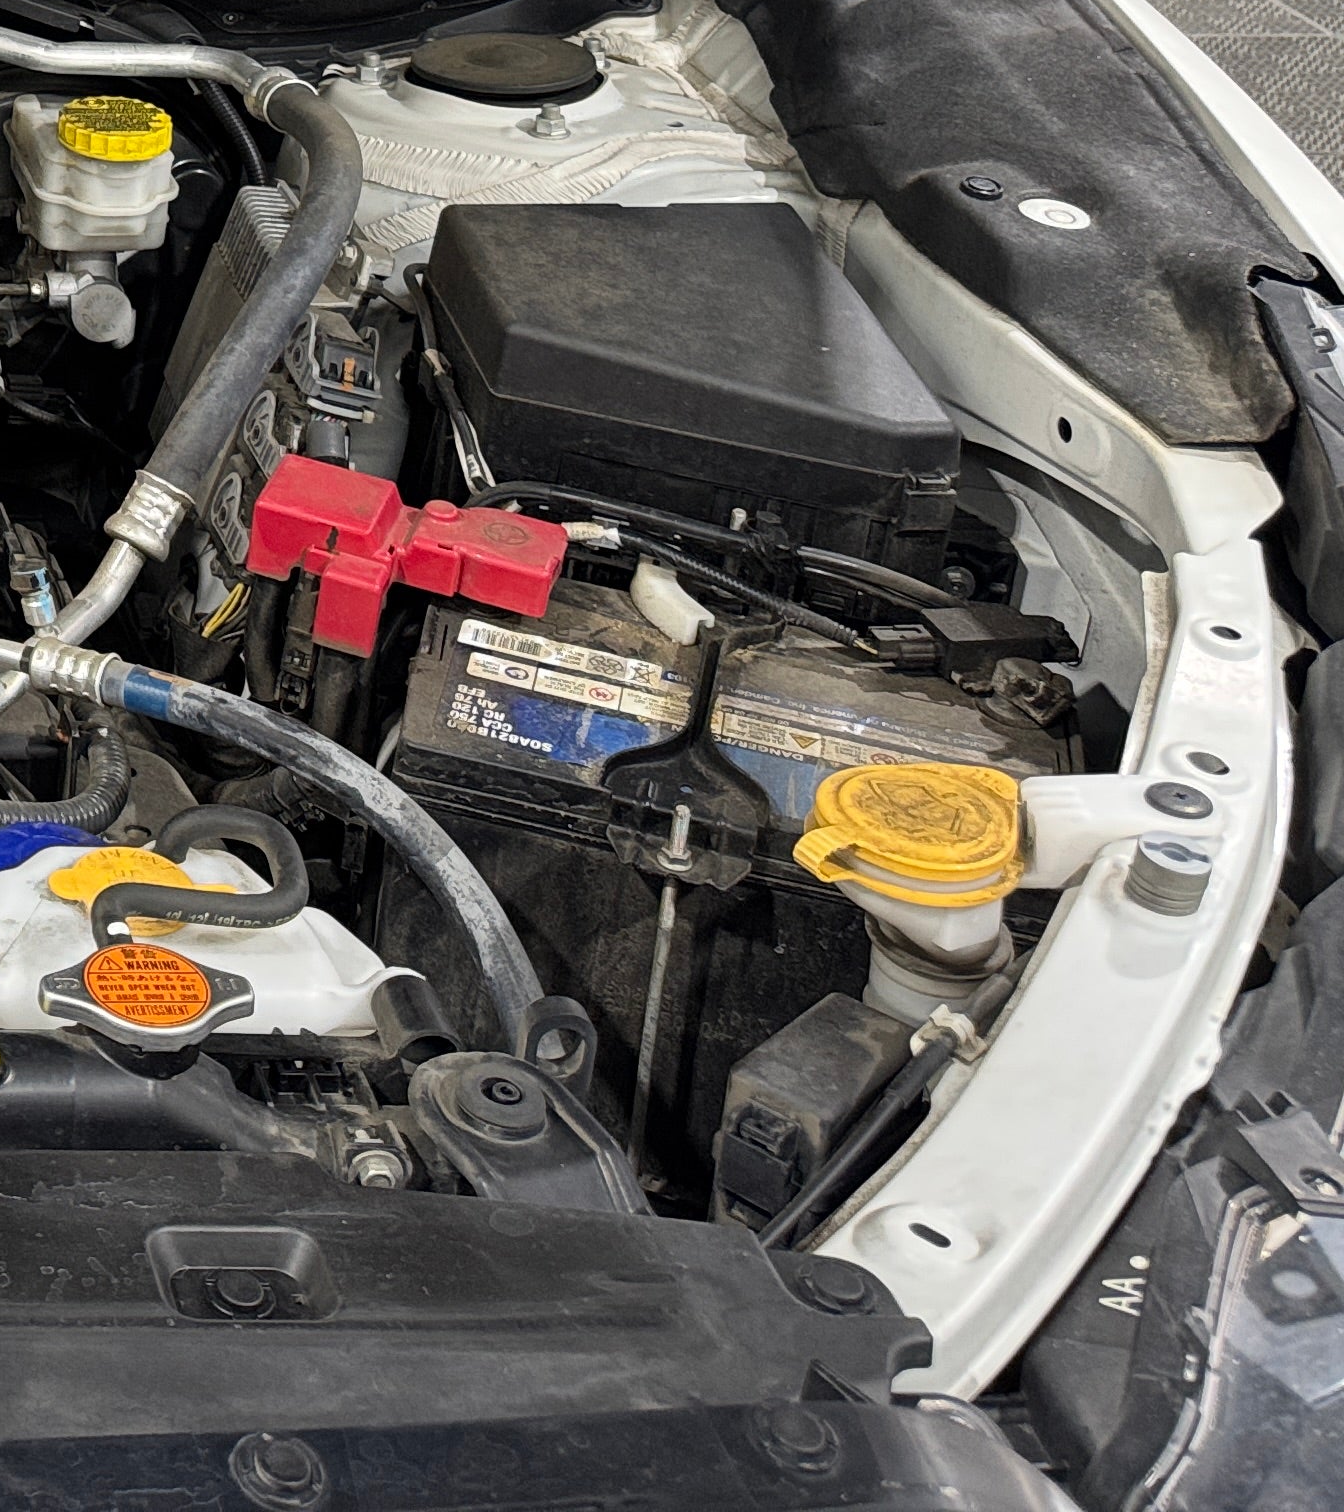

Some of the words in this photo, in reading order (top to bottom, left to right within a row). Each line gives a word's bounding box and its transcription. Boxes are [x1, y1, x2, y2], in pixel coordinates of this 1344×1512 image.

[457, 683, 486, 698] EFB
[451, 701, 480, 715] 120
[476, 697, 499, 710] Ah
[449, 709, 478, 724] 750
[483, 708, 506, 722] RC
[481, 717, 514, 733] CCA
[123, 960, 180, 971] WARNING
